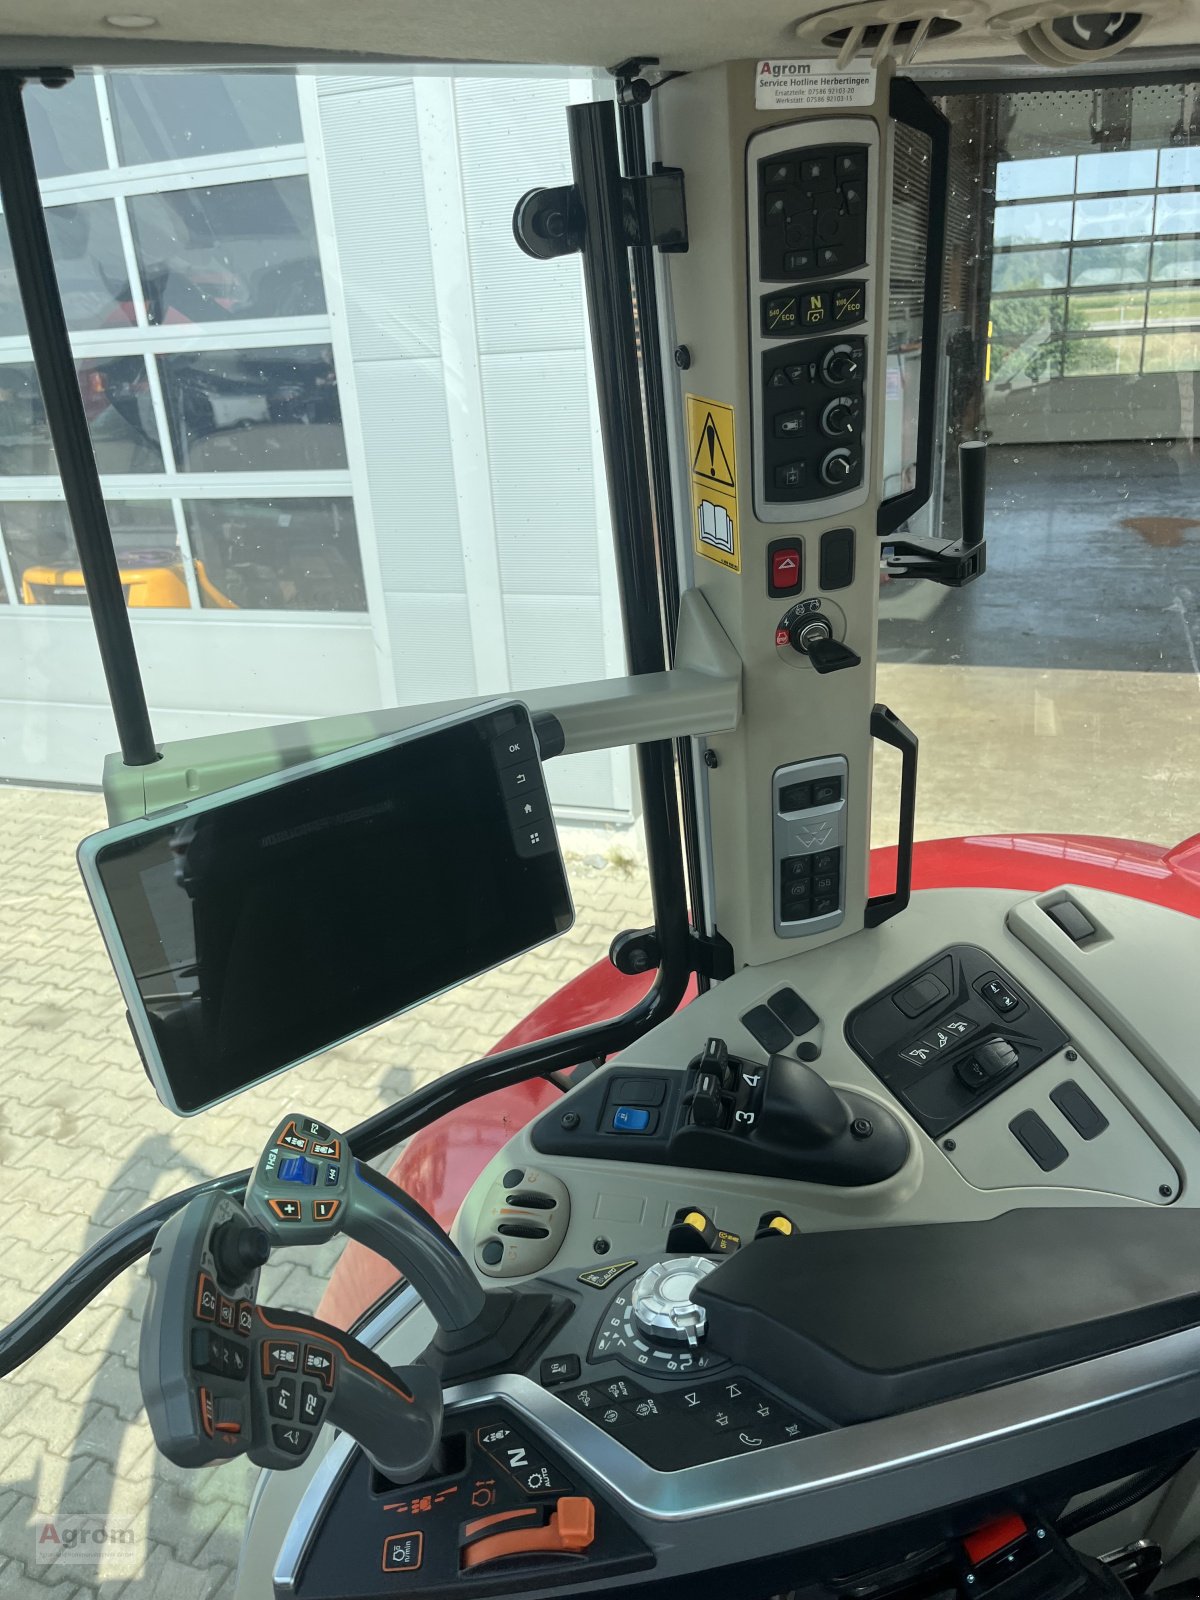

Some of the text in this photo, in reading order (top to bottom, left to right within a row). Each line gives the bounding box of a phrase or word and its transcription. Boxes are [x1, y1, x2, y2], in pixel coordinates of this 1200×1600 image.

[760, 62, 811, 77] Agrom
[759, 77, 870, 88] Service Hotline Herbertingen
[810, 295, 822, 309] N
[847, 303, 860, 311] ECO
[769, 309, 780, 317] 540
[509, 743, 521, 753] OK
[742, 1074, 761, 1087] 4
[735, 1110, 755, 1125] 3
[310, 1122, 319, 1135] F3
[269, 1152, 277, 1164] H3
[329, 1168, 337, 1180] H4
[603, 1267, 618, 1280] AUTO
[616, 1297, 626, 1306] 5
[611, 1317, 621, 1327] 6
[617, 1339, 627, 1347] 7
[638, 1354, 648, 1364] 8
[667, 1360, 677, 1370] 9
[279, 1389, 291, 1409] F1
[305, 1394, 317, 1416] F2
[507, 1448, 529, 1468] N
[540, 1467, 551, 1487] AUTO
[404, 1540, 412, 1563] n/min
